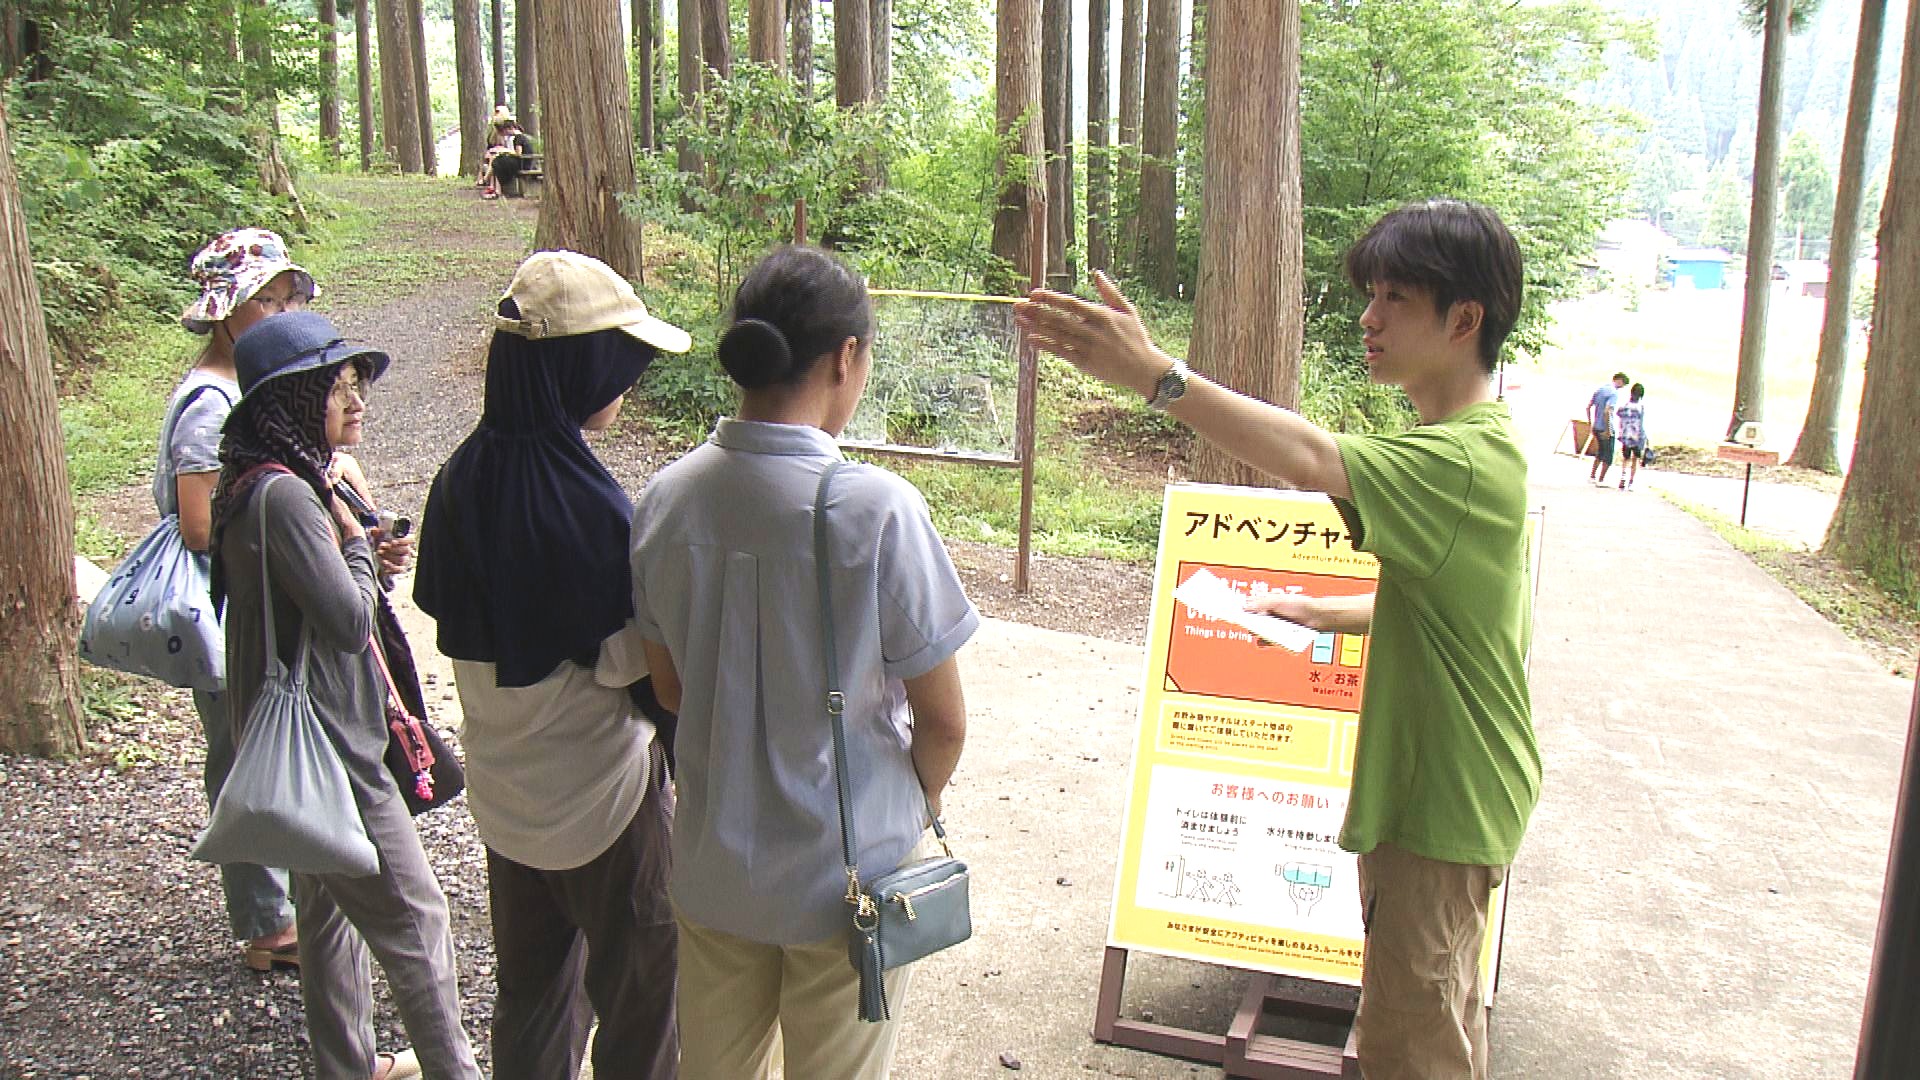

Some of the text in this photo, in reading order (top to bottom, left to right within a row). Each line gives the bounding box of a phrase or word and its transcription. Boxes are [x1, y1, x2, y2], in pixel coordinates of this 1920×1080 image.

[1185, 626, 1253, 643] Things to bring
[1211, 783, 1329, 808] お客様へのお願い
